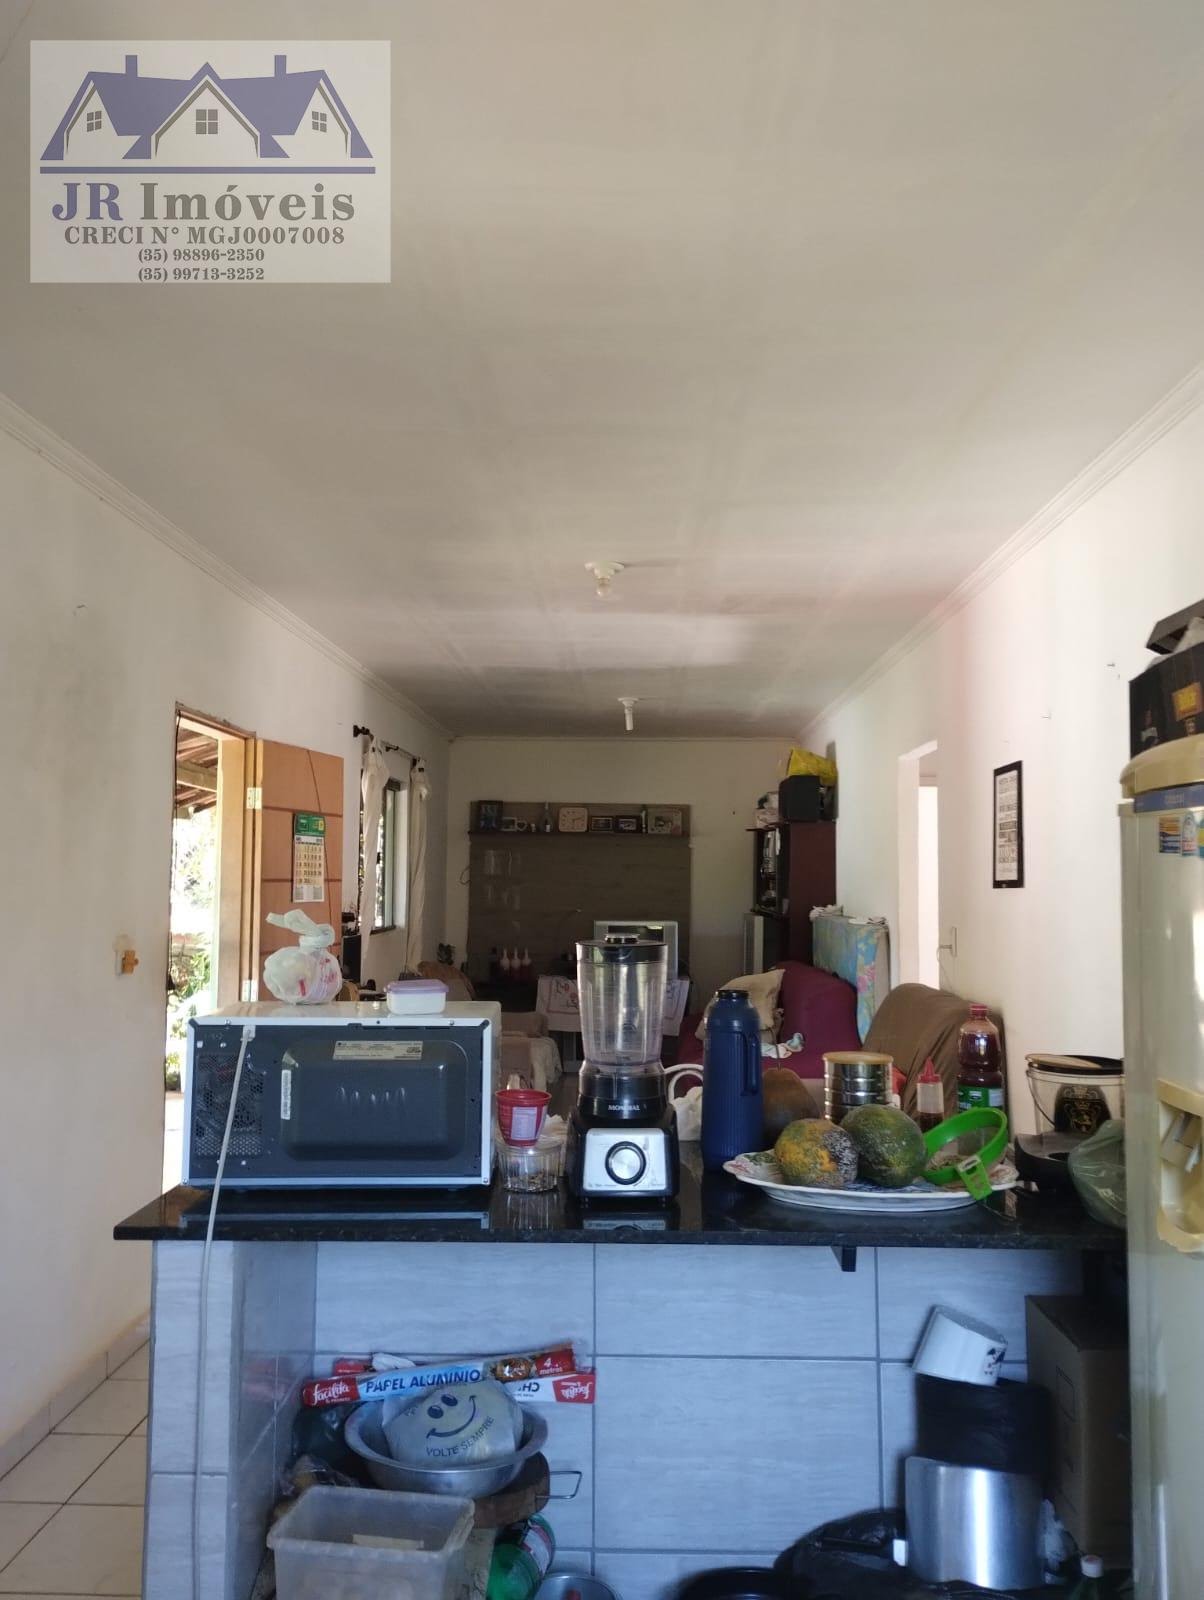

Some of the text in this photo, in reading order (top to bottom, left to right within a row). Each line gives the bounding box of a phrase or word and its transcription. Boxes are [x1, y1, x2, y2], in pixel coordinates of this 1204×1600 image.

[366, 1369, 480, 1393] PAPEL ALUMINIO
[518, 1382, 540, 1392] CH
[426, 1416, 495, 1457] VOLTE SEMPRE
